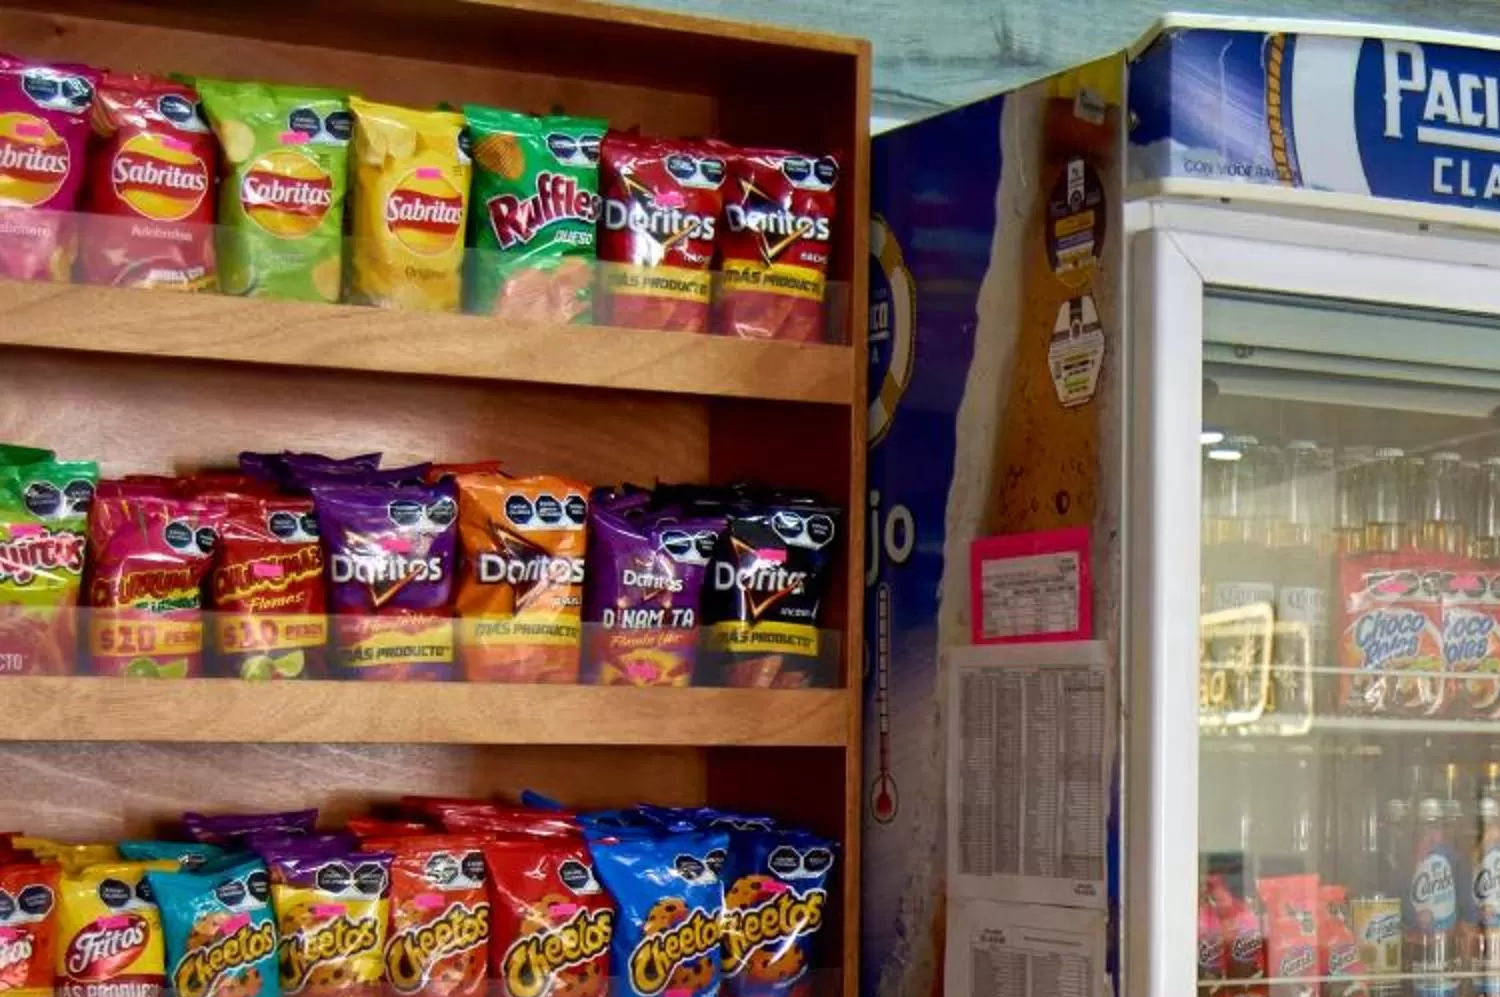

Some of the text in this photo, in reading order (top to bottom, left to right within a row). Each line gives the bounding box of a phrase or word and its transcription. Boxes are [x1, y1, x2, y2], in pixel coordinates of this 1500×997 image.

[0, 142, 69, 175] britas
[113, 158, 207, 192] Sabritas
[240, 176, 333, 207] Sabritas
[385, 195, 463, 226] Sabritas
[487, 172, 601, 251] Ruffles
[604, 198, 717, 242] Doritos
[726, 202, 830, 240] Doritos
[553, 228, 593, 245] QUESO
[331, 552, 443, 585] Doritos
[480, 553, 586, 586] Doritos
[622, 566, 685, 594] Doritos
[99, 625, 157, 653] $10
[1355, 610, 1426, 647] Choco
[69, 920, 146, 974] Fritos
[280, 915, 381, 994] Cheetos
[385, 903, 491, 995] Cheetos
